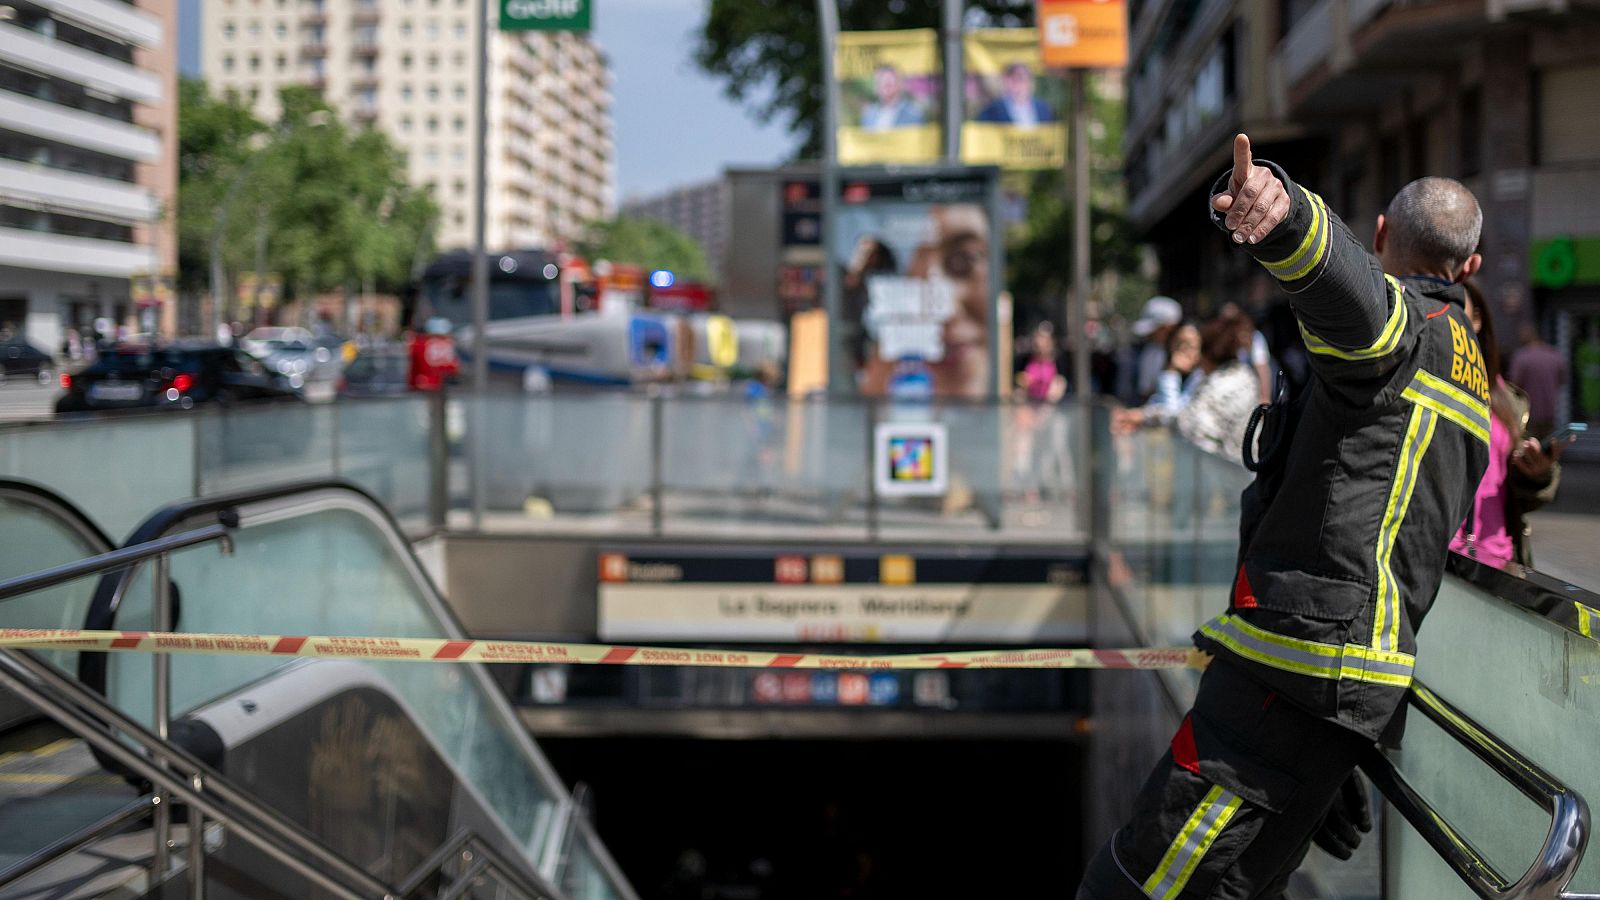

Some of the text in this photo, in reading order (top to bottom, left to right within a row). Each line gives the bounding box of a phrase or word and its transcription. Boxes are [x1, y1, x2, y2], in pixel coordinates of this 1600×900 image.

[195, 638, 215, 650] FIRE
[216, 639, 269, 651] BARCELONA
[314, 644, 368, 656] BARCELONA
[486, 643, 568, 657] NO PASSAR
[641, 650, 748, 664] DO NOT CROSS
